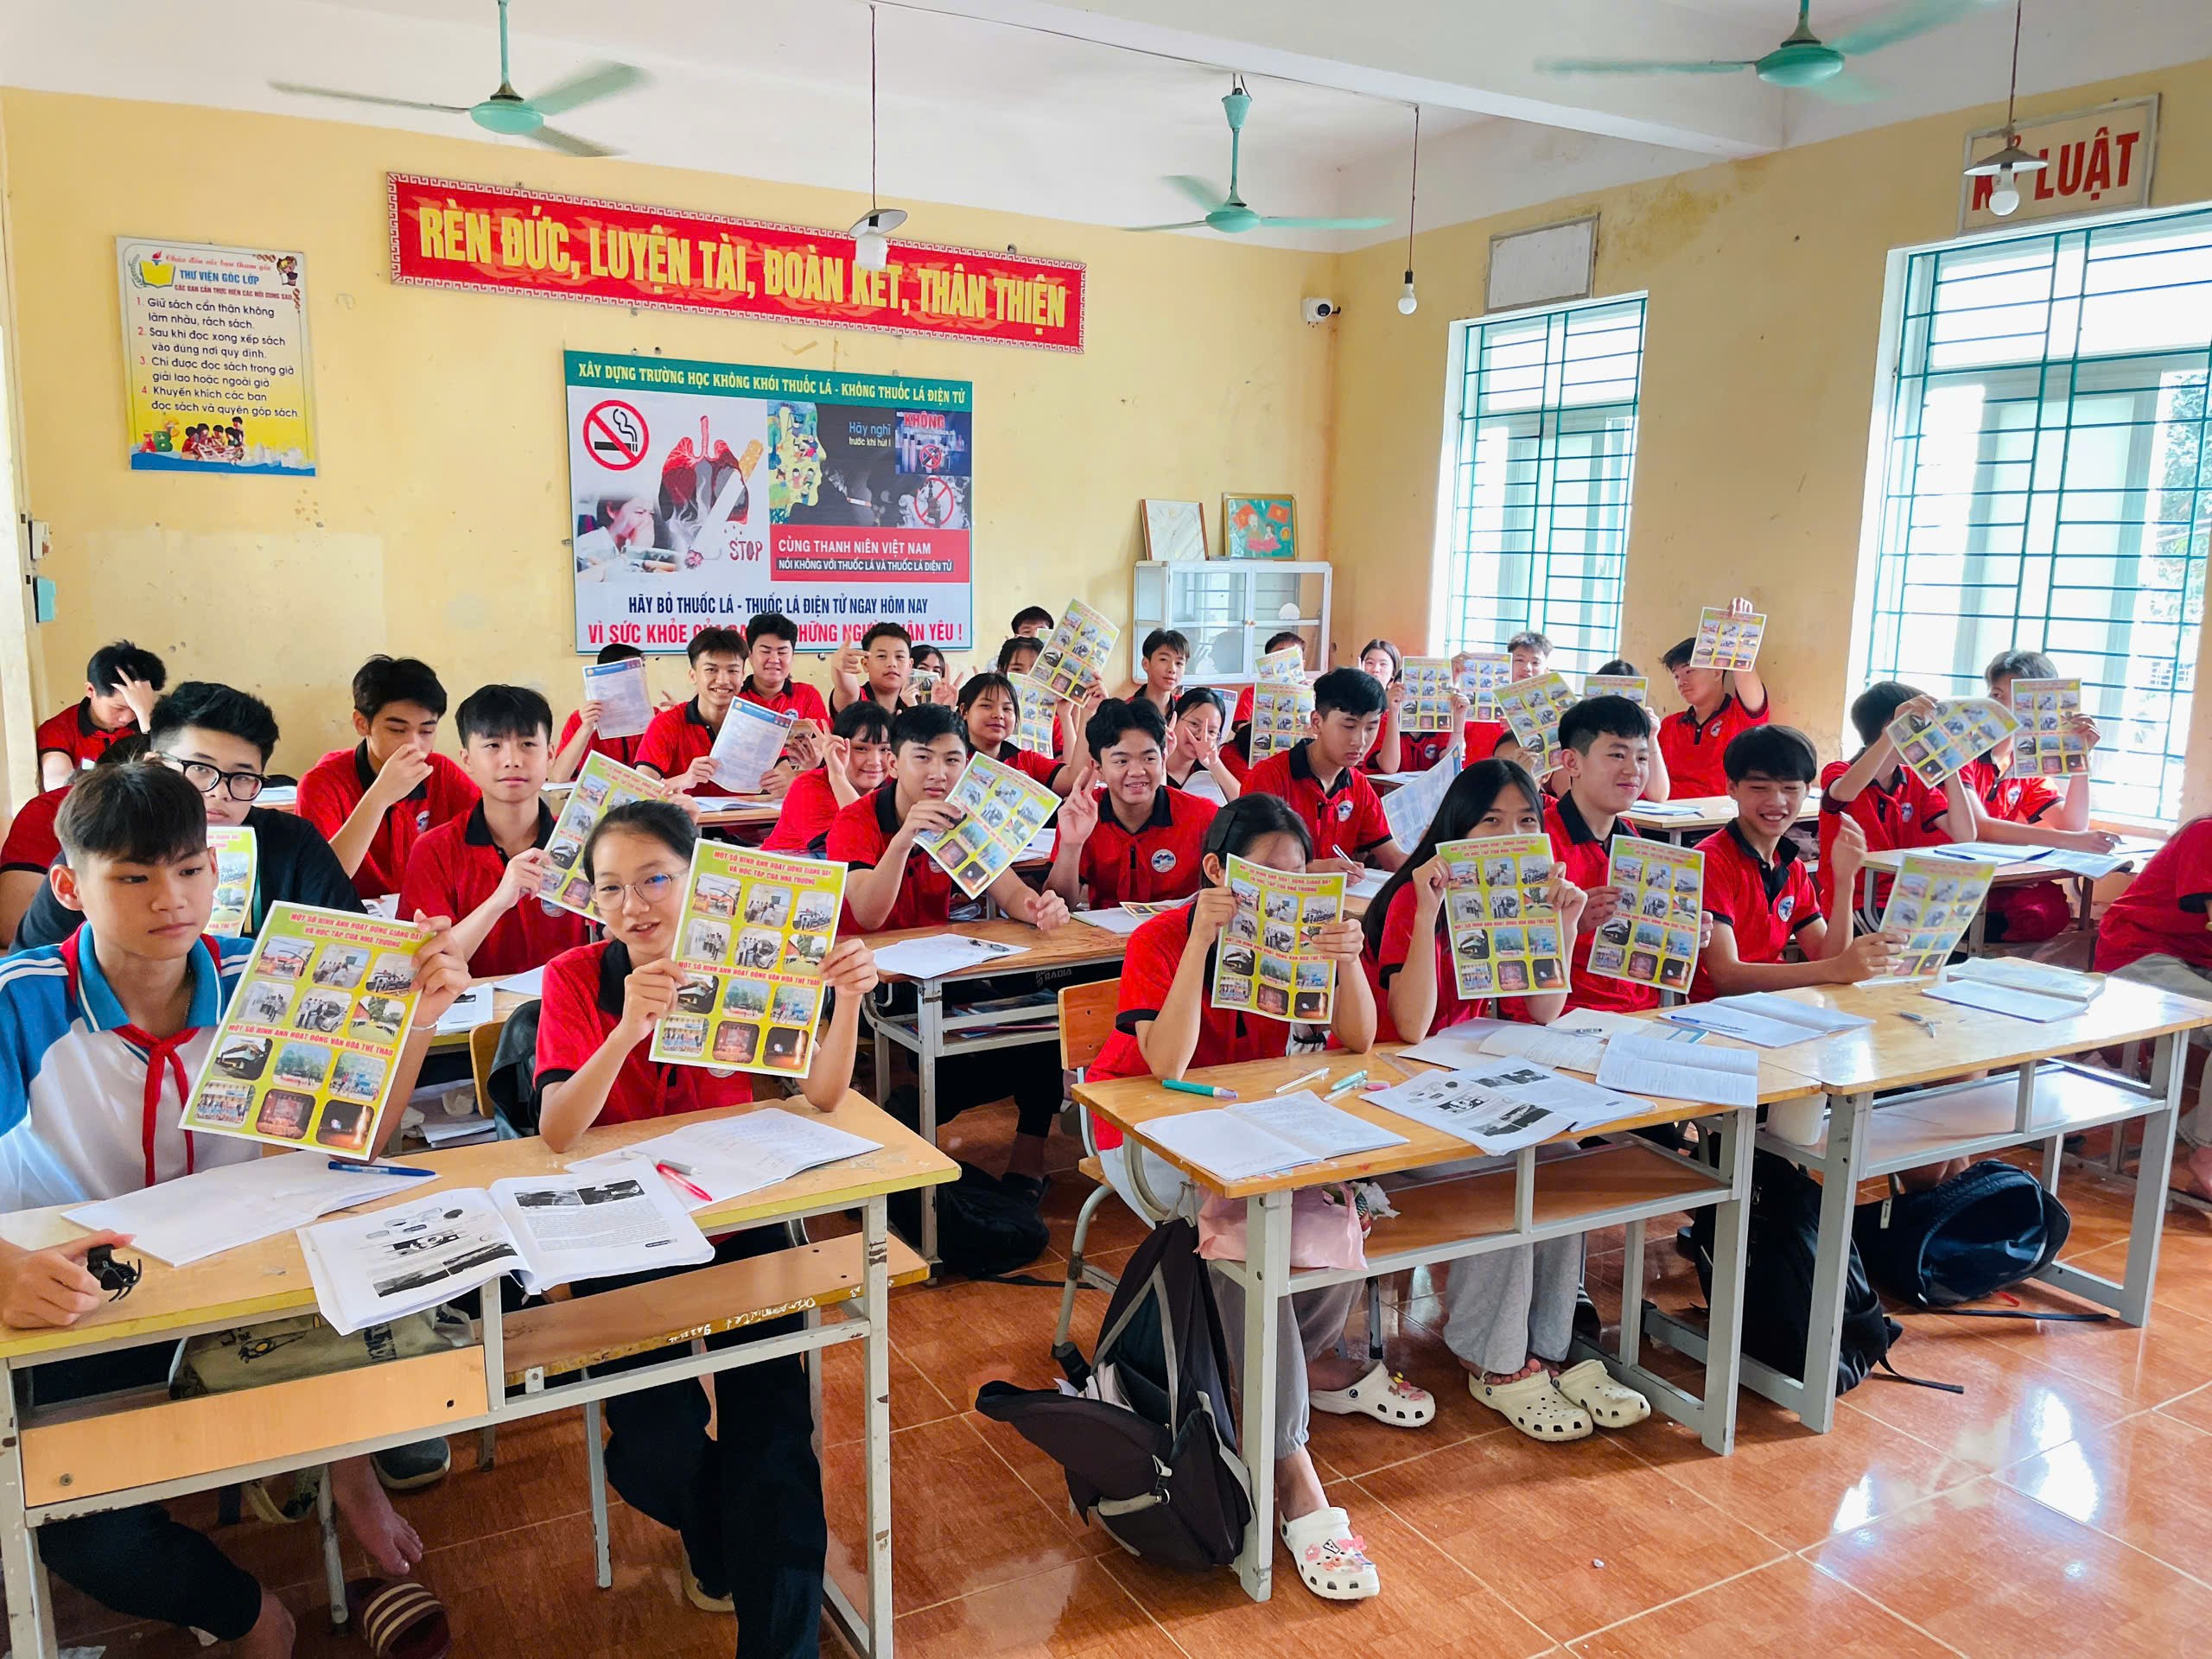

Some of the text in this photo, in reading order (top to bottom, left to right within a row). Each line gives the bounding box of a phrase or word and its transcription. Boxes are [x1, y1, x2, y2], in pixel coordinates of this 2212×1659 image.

[2034, 126, 2140, 201] LUẬT
[418, 198, 492, 264] RÈN
[500, 206, 582, 281] ĐỨC,
[589, 225, 690, 295] LUYỆN
[699, 233, 755, 299] TÀI,
[764, 245, 843, 304] ĐOÀN
[917, 263, 987, 320] THÂN
[994, 273, 1065, 335] THIỆN
[180, 270, 259, 285] THƯ VIỆN GÓC LỚP
[148, 297, 166, 308] Giữ
[168, 299, 193, 310] sách
[196, 299, 216, 311] cẩn
[218, 303, 241, 315] thận
[243, 304, 275, 318] không
[149, 313, 168, 323] làm
[171, 315, 200, 327] nhàu,
[202, 315, 226, 327] rách
[149, 327, 168, 338] Sau
[171, 329, 186, 339] khi
[188, 330, 209, 341] đọc
[213, 335, 238, 345] xong
[240, 334, 259, 346] xếp
[262, 336, 286, 346] sách
[152, 341, 170, 352] vào
[173, 344, 200, 356] đúng
[202, 346, 218, 355] nơi
[221, 350, 239, 359] quy
[151, 356, 168, 366] Chỉ
[171, 357, 198, 371] được
[200, 359, 220, 372] đọc
[224, 361, 248, 372] sách
[251, 364, 276, 376] trong
[278, 366, 294, 377] giờ
[152, 372, 172, 383] giải
[175, 372, 190, 383] lao
[193, 374, 219, 387] hoặc
[222, 377, 251, 387] ngoài
[578, 360, 602, 378] XÂY
[605, 365, 637, 383] DỰNG
[639, 365, 684, 385] TRƯỜNG
[688, 372, 709, 389] HỌC
[713, 372, 750, 389] KHÔNG
[753, 374, 779, 391] KHÓI
[782, 374, 817, 394] THUỐC
[819, 378, 832, 395] LÁ
[842, 380, 875, 398] KHÔNG
[878, 381, 910, 400] THUỐC
[913, 385, 925, 401] LÁ
[927, 387, 950, 406] ĐIỆN
[952, 387, 965, 404] TỬ
[153, 385, 192, 398] Khuyến
[194, 388, 222, 399] khích
[225, 391, 245, 400] các
[247, 391, 267, 403] bạn
[151, 401, 172, 411] đọc
[175, 402, 200, 412] sách
[201, 404, 215, 413] và
[217, 405, 249, 416] quyên
[251, 408, 272, 418] góp
[904, 410, 945, 429] KHÔNG
[849, 422, 891, 438] Hãy nghĩ
[729, 540, 763, 562] STOP
[779, 536, 931, 557] CÙNG THANH NIÊN VIỆT NAM
[779, 557, 953, 574] NÓI KHÔNG VỚI THUỐC LÁ VÀ THUỐC LÁ ĐIỆN TỬ
[629, 594, 652, 613] HÃY
[658, 592, 673, 613] BỎ
[677, 592, 715, 613] THUỐC
[720, 593, 734, 613] LÁ
[746, 591, 782, 614] THUỐC
[786, 594, 800, 613] LÁ
[803, 595, 830, 617] ĐIỆN
[833, 593, 847, 613] TỬ
[849, 599, 877, 613] NGAY
[881, 595, 904, 613] HÔM
[908, 599, 928, 613] NAY
[588, 620, 603, 643] VÌ
[609, 620, 641, 644] SỨC
[646, 618, 688, 643] KHỎE
[799, 620, 837, 642] HỮNG
[929, 619, 953, 641] YÊU
[958, 623, 962, 640] !
